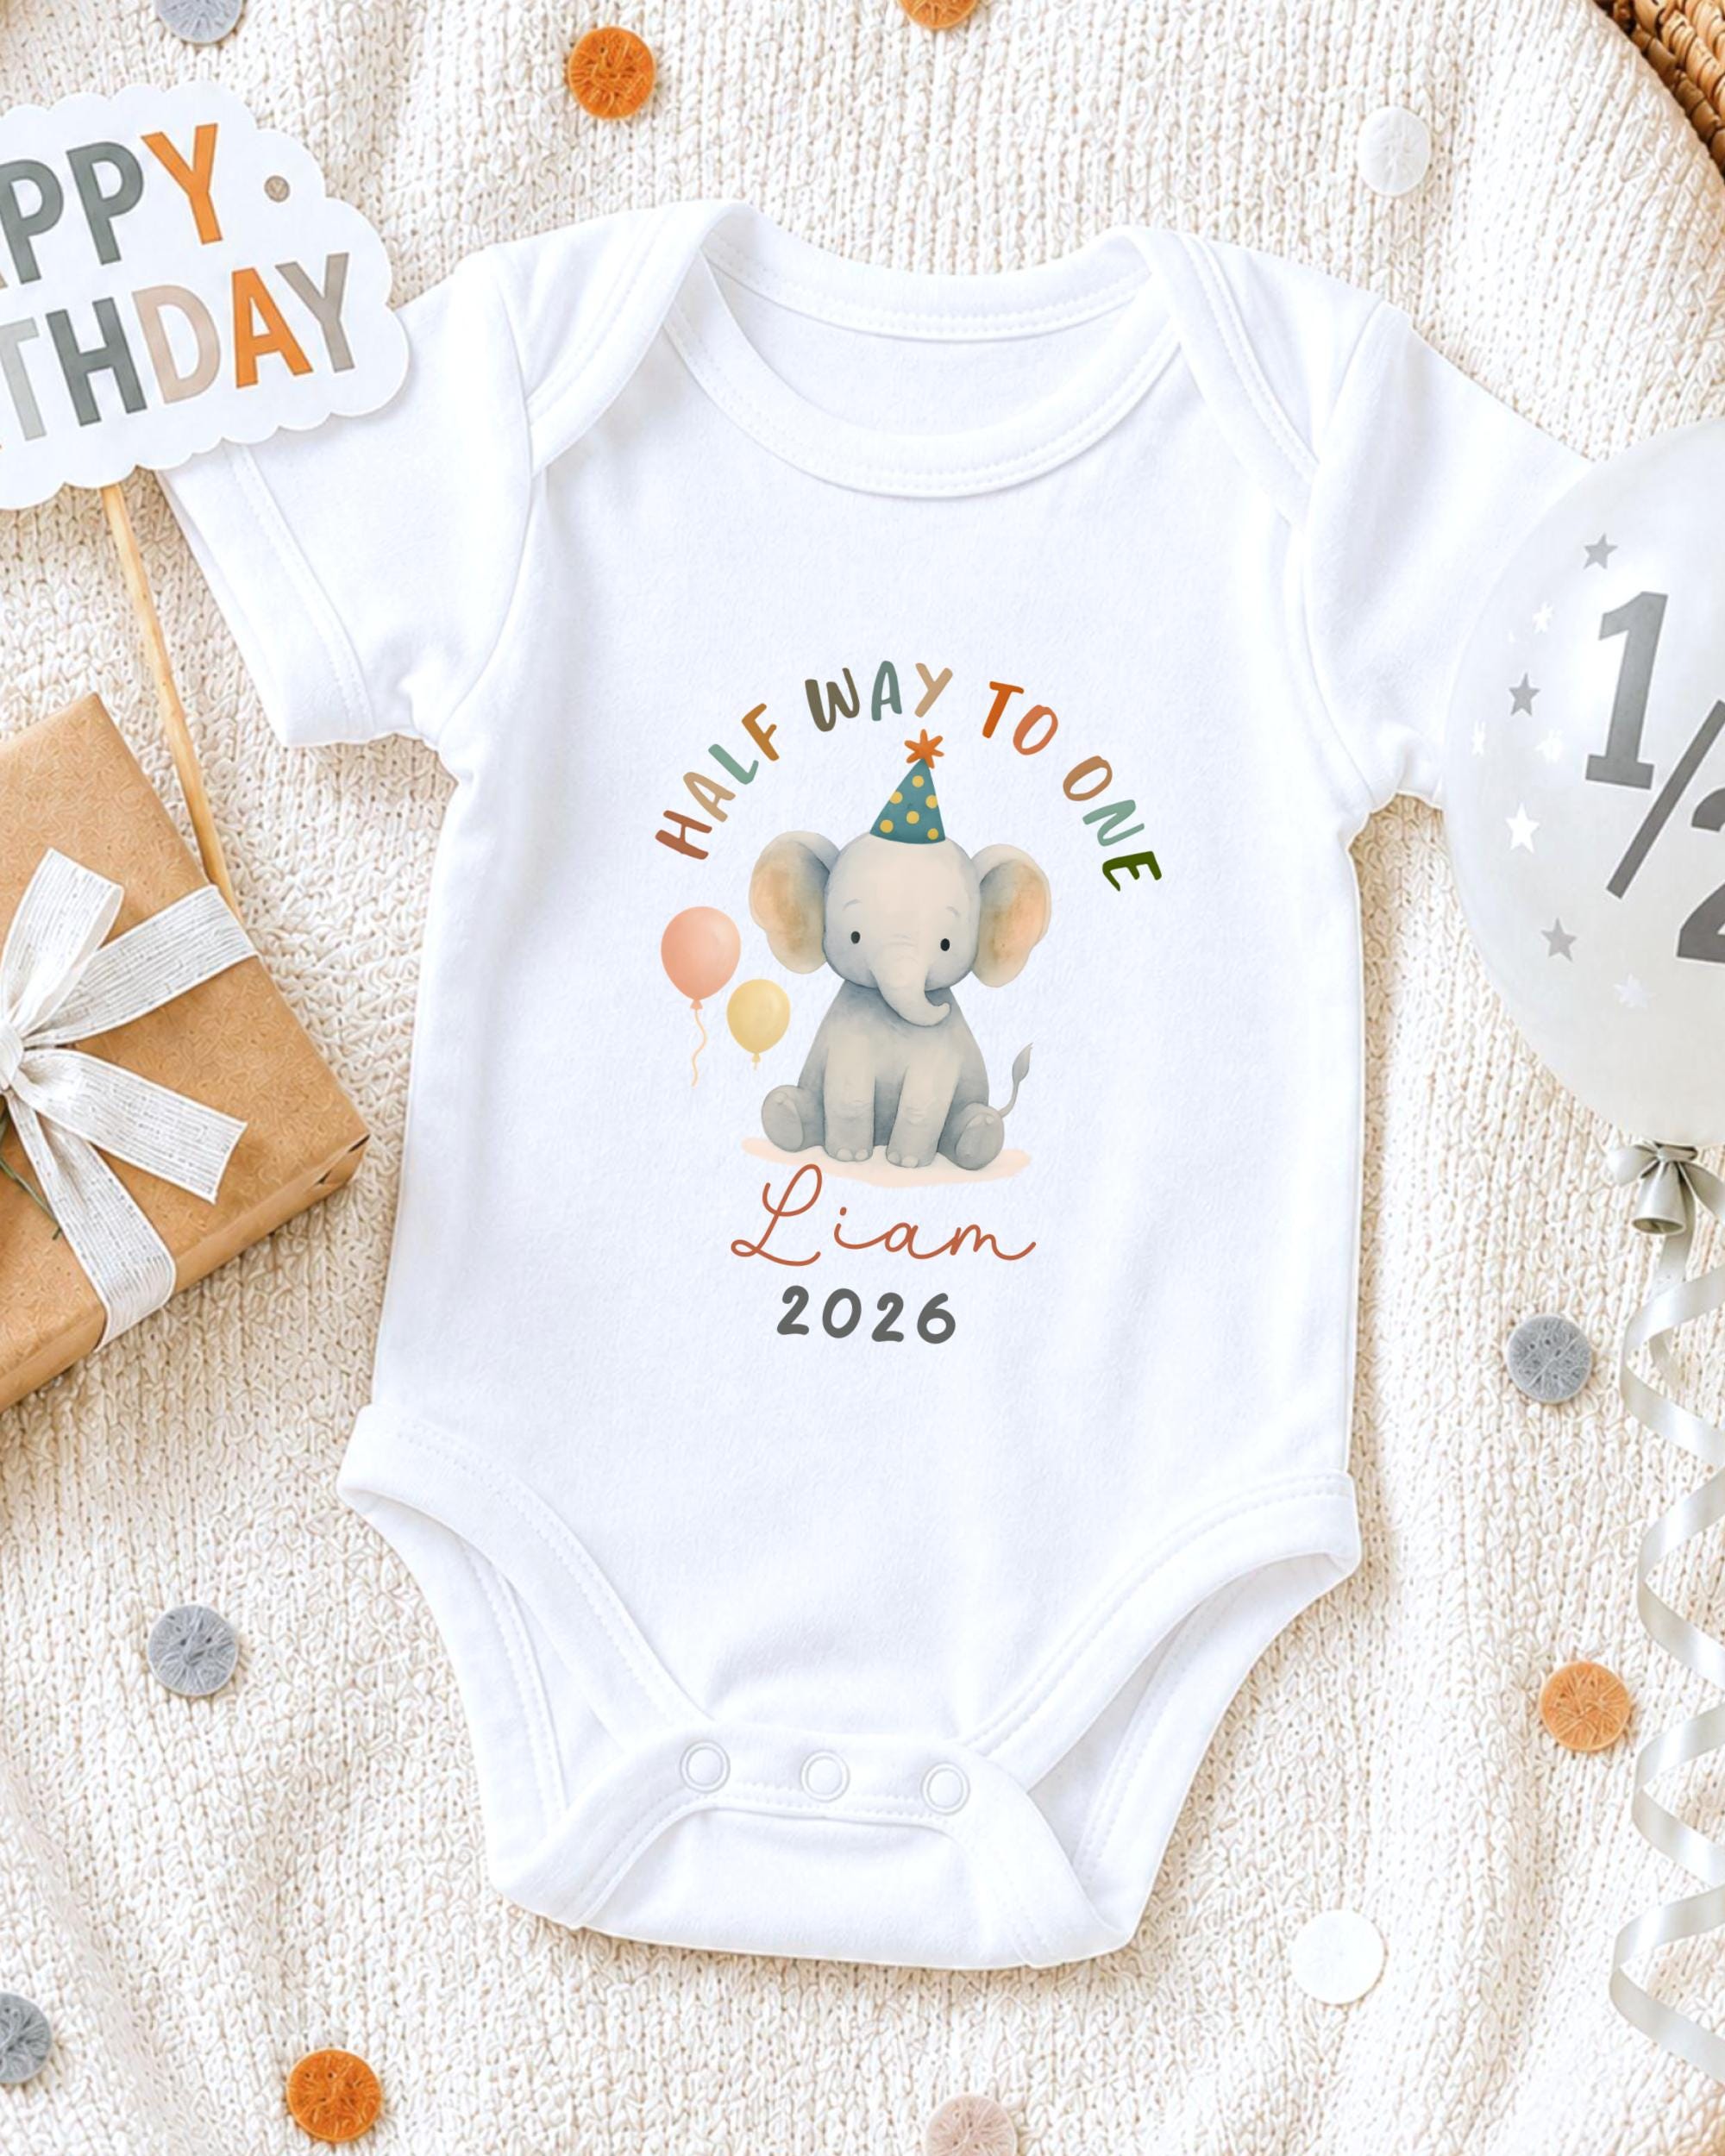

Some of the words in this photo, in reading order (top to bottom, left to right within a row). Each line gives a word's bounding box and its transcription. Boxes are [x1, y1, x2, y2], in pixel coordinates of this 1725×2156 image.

[0, 122, 223, 289] PPY
[0, 253, 355, 449] THDAY
[655, 703, 781, 861] HALF
[805, 661, 954, 733] WAY
[982, 680, 1059, 756] TO
[1063, 755, 1163, 892] ONE
[731, 1163, 1037, 1267] Liam
[776, 1285, 957, 1344] 2026
